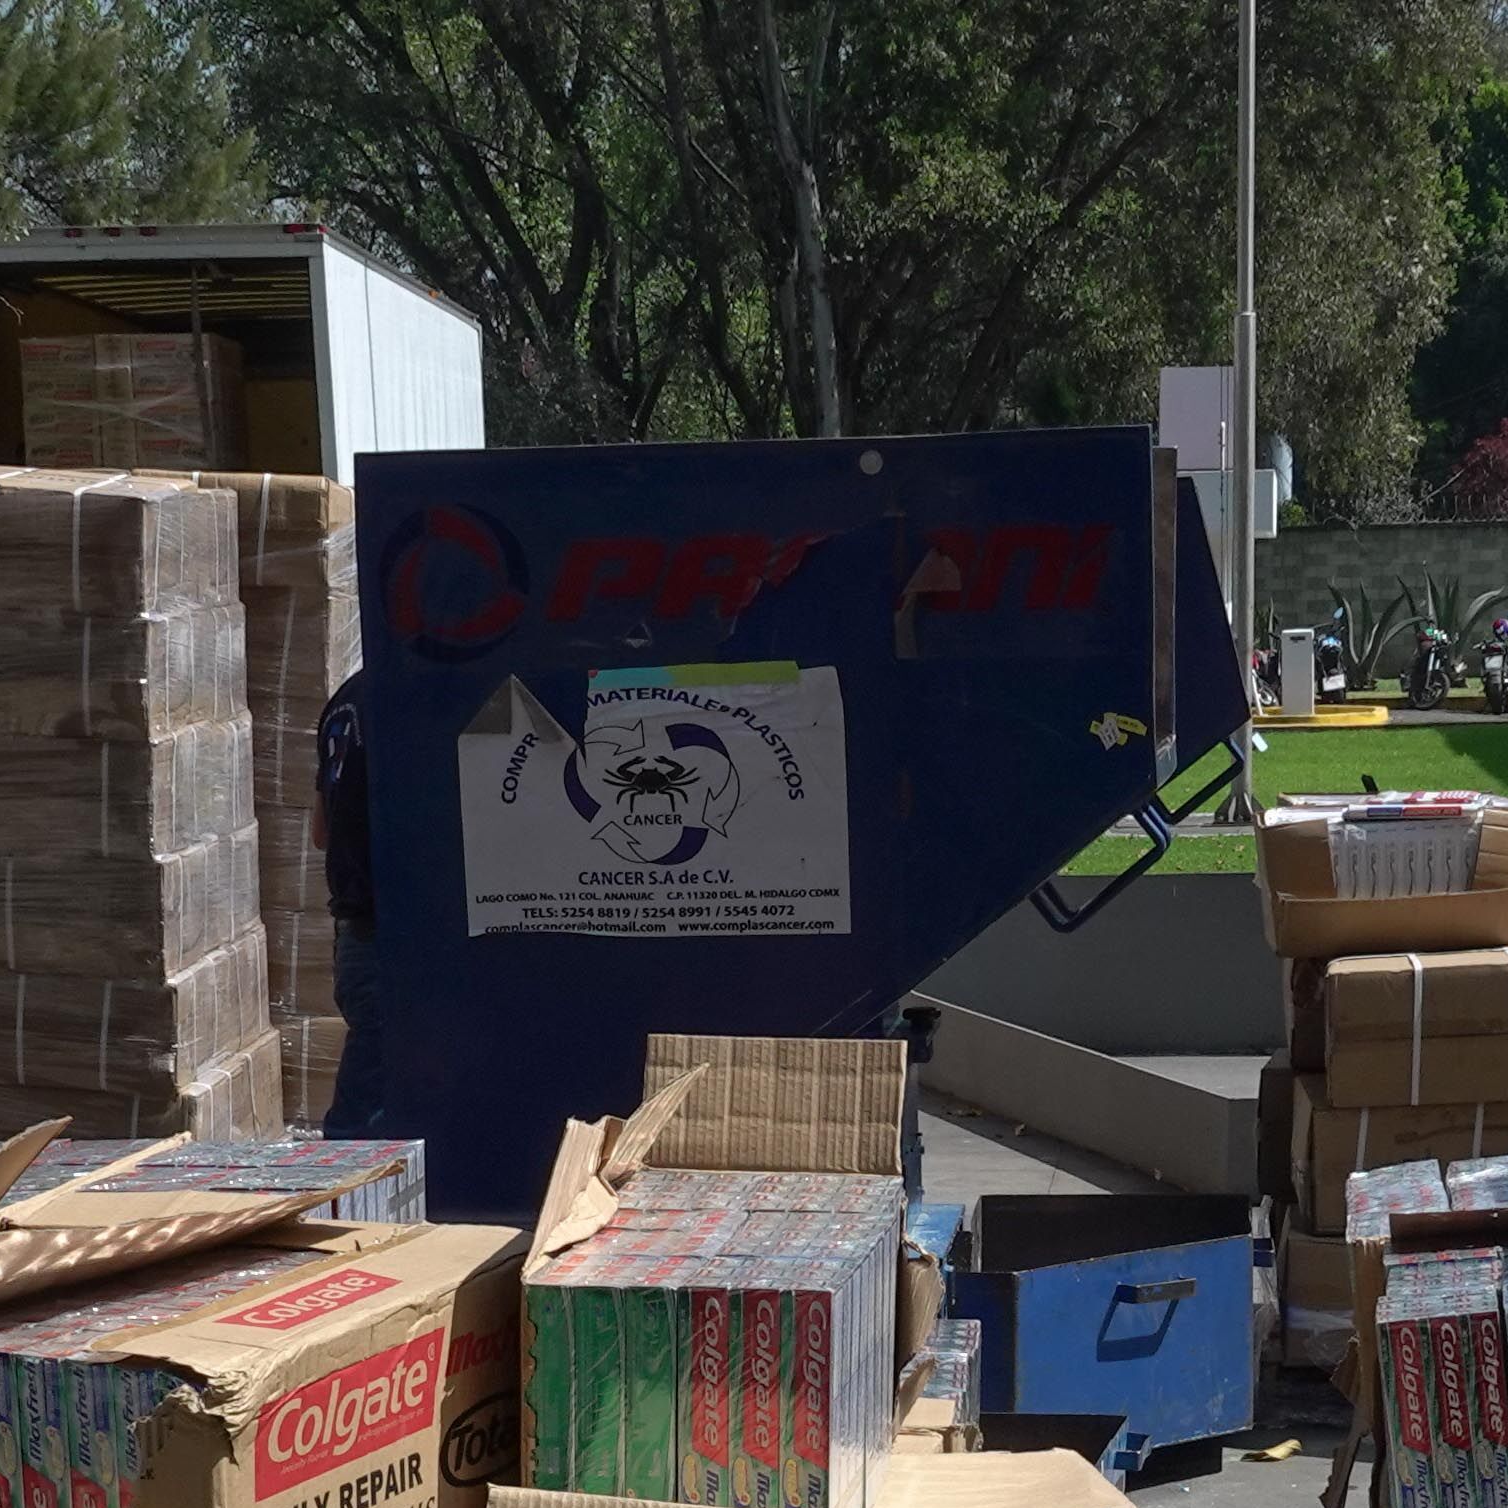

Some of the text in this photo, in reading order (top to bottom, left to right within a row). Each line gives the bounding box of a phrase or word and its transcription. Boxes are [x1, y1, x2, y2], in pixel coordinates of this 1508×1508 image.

[501, 732, 540, 804] COMPR
[731, 707, 805, 801] PLASTICOS
[623, 814, 682, 826] CANCER
[476, 894, 503, 904] LAGO
[505, 894, 537, 903] COMO
[559, 893, 576, 901] 121
[604, 892, 655, 901] ANAHUAC
[687, 890, 718, 900] 11320
[759, 889, 806, 899] HIDALGO
[808, 888, 840, 898] CDMX
[522, 904, 795, 919] TELS: 5254 8819 5254 8991 5545 4072
[579, 872, 645, 886] CANCER
[678, 871, 698, 884] de
[703, 870, 734, 884] C.V.
[678, 919, 834, 933] www.complascancer.com
[243, 1274, 377, 1326] Colgate
[267, 1359, 430, 1465] Colgate
[700, 1297, 724, 1446] Colgate
[752, 1299, 774, 1448] Colgate
[803, 1301, 827, 1450] Colgate
[1400, 1327, 1423, 1441] Colgate
[1441, 1322, 1464, 1437] Colgate
[1481, 1319, 1503, 1434] Colgate
